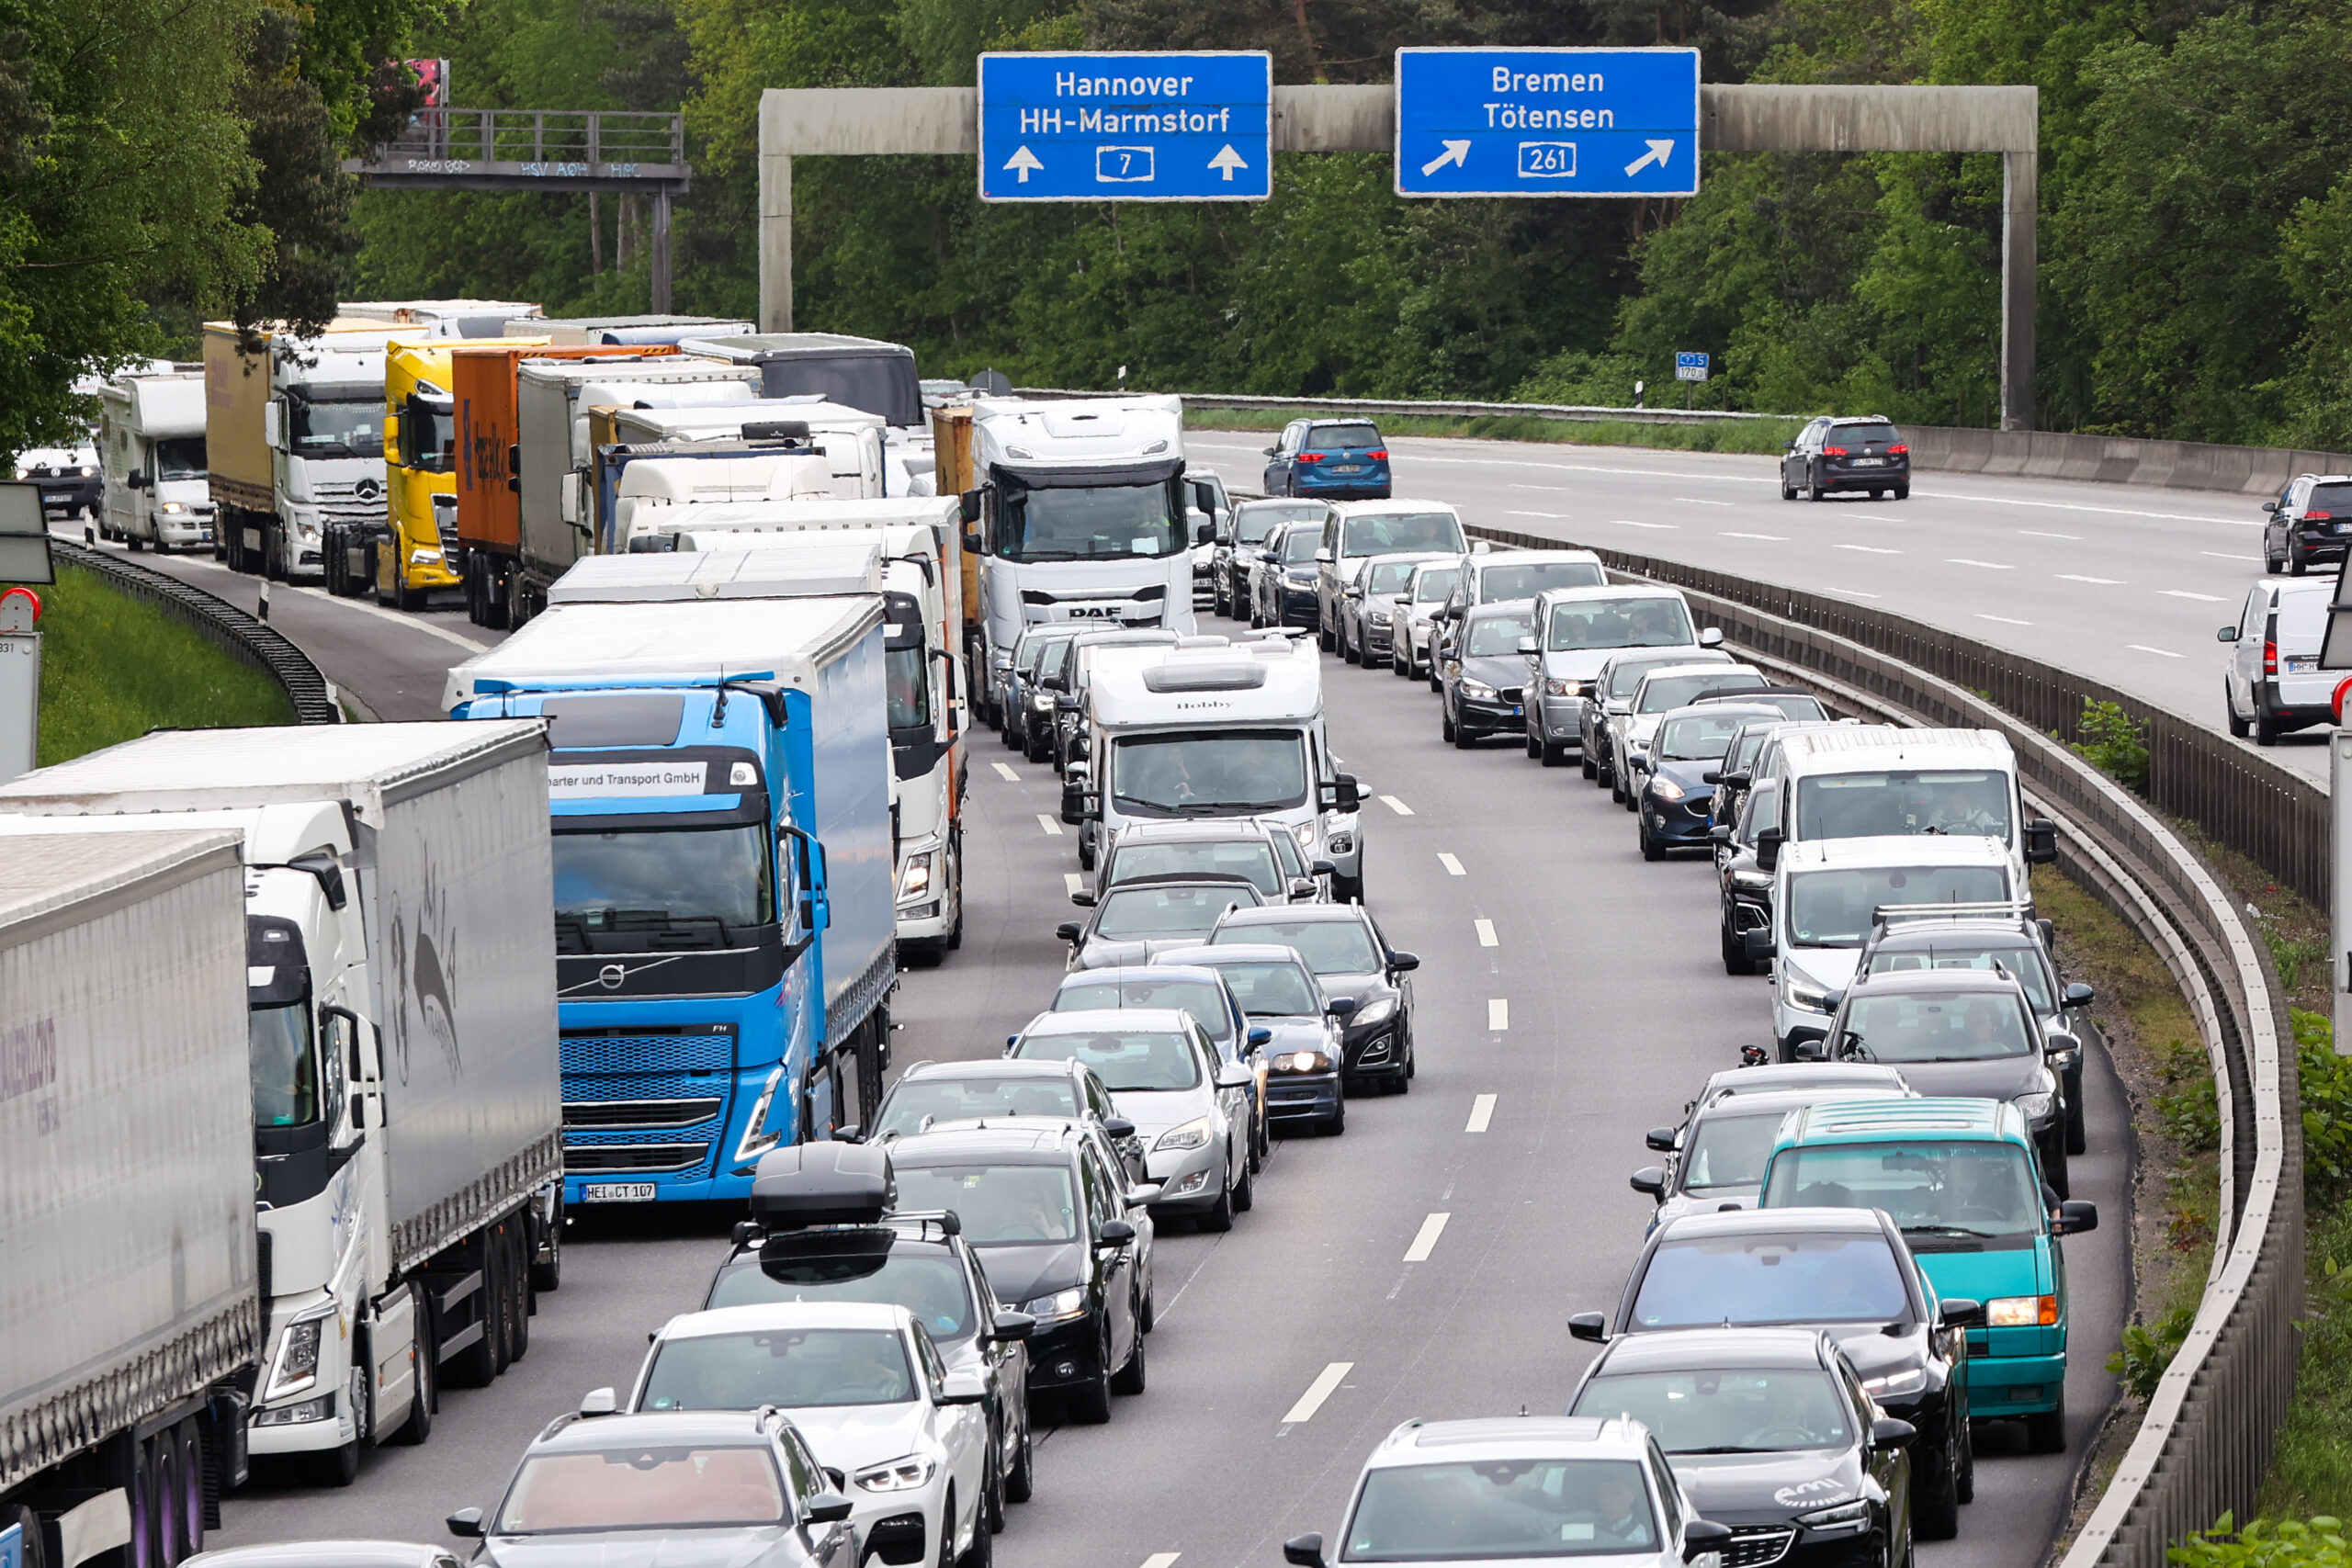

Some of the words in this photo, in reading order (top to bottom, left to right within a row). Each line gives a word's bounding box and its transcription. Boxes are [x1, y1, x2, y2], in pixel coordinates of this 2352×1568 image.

[1056, 72, 1193, 96] Hannover
[1493, 66, 1604, 92] Bremen
[1020, 107, 1230, 133] HH-Marmstorf
[1483, 103, 1614, 129] Tötensen
[1119, 152, 1132, 175] 7
[1530, 148, 1566, 170] 261
[521, 162, 548, 177] HSV
[1697, 355, 1705, 366] S
[1069, 607, 1122, 617] DAF
[1177, 701, 1233, 711] Hobby
[582, 774, 603, 785] und
[606, 773, 661, 787] Transport
[663, 772, 700, 784] GmbH
[712, 1024, 728, 1032] FH
[587, 1186, 607, 1199] HEI
[615, 1185, 629, 1198] CT
[631, 1185, 652, 1198] 107
